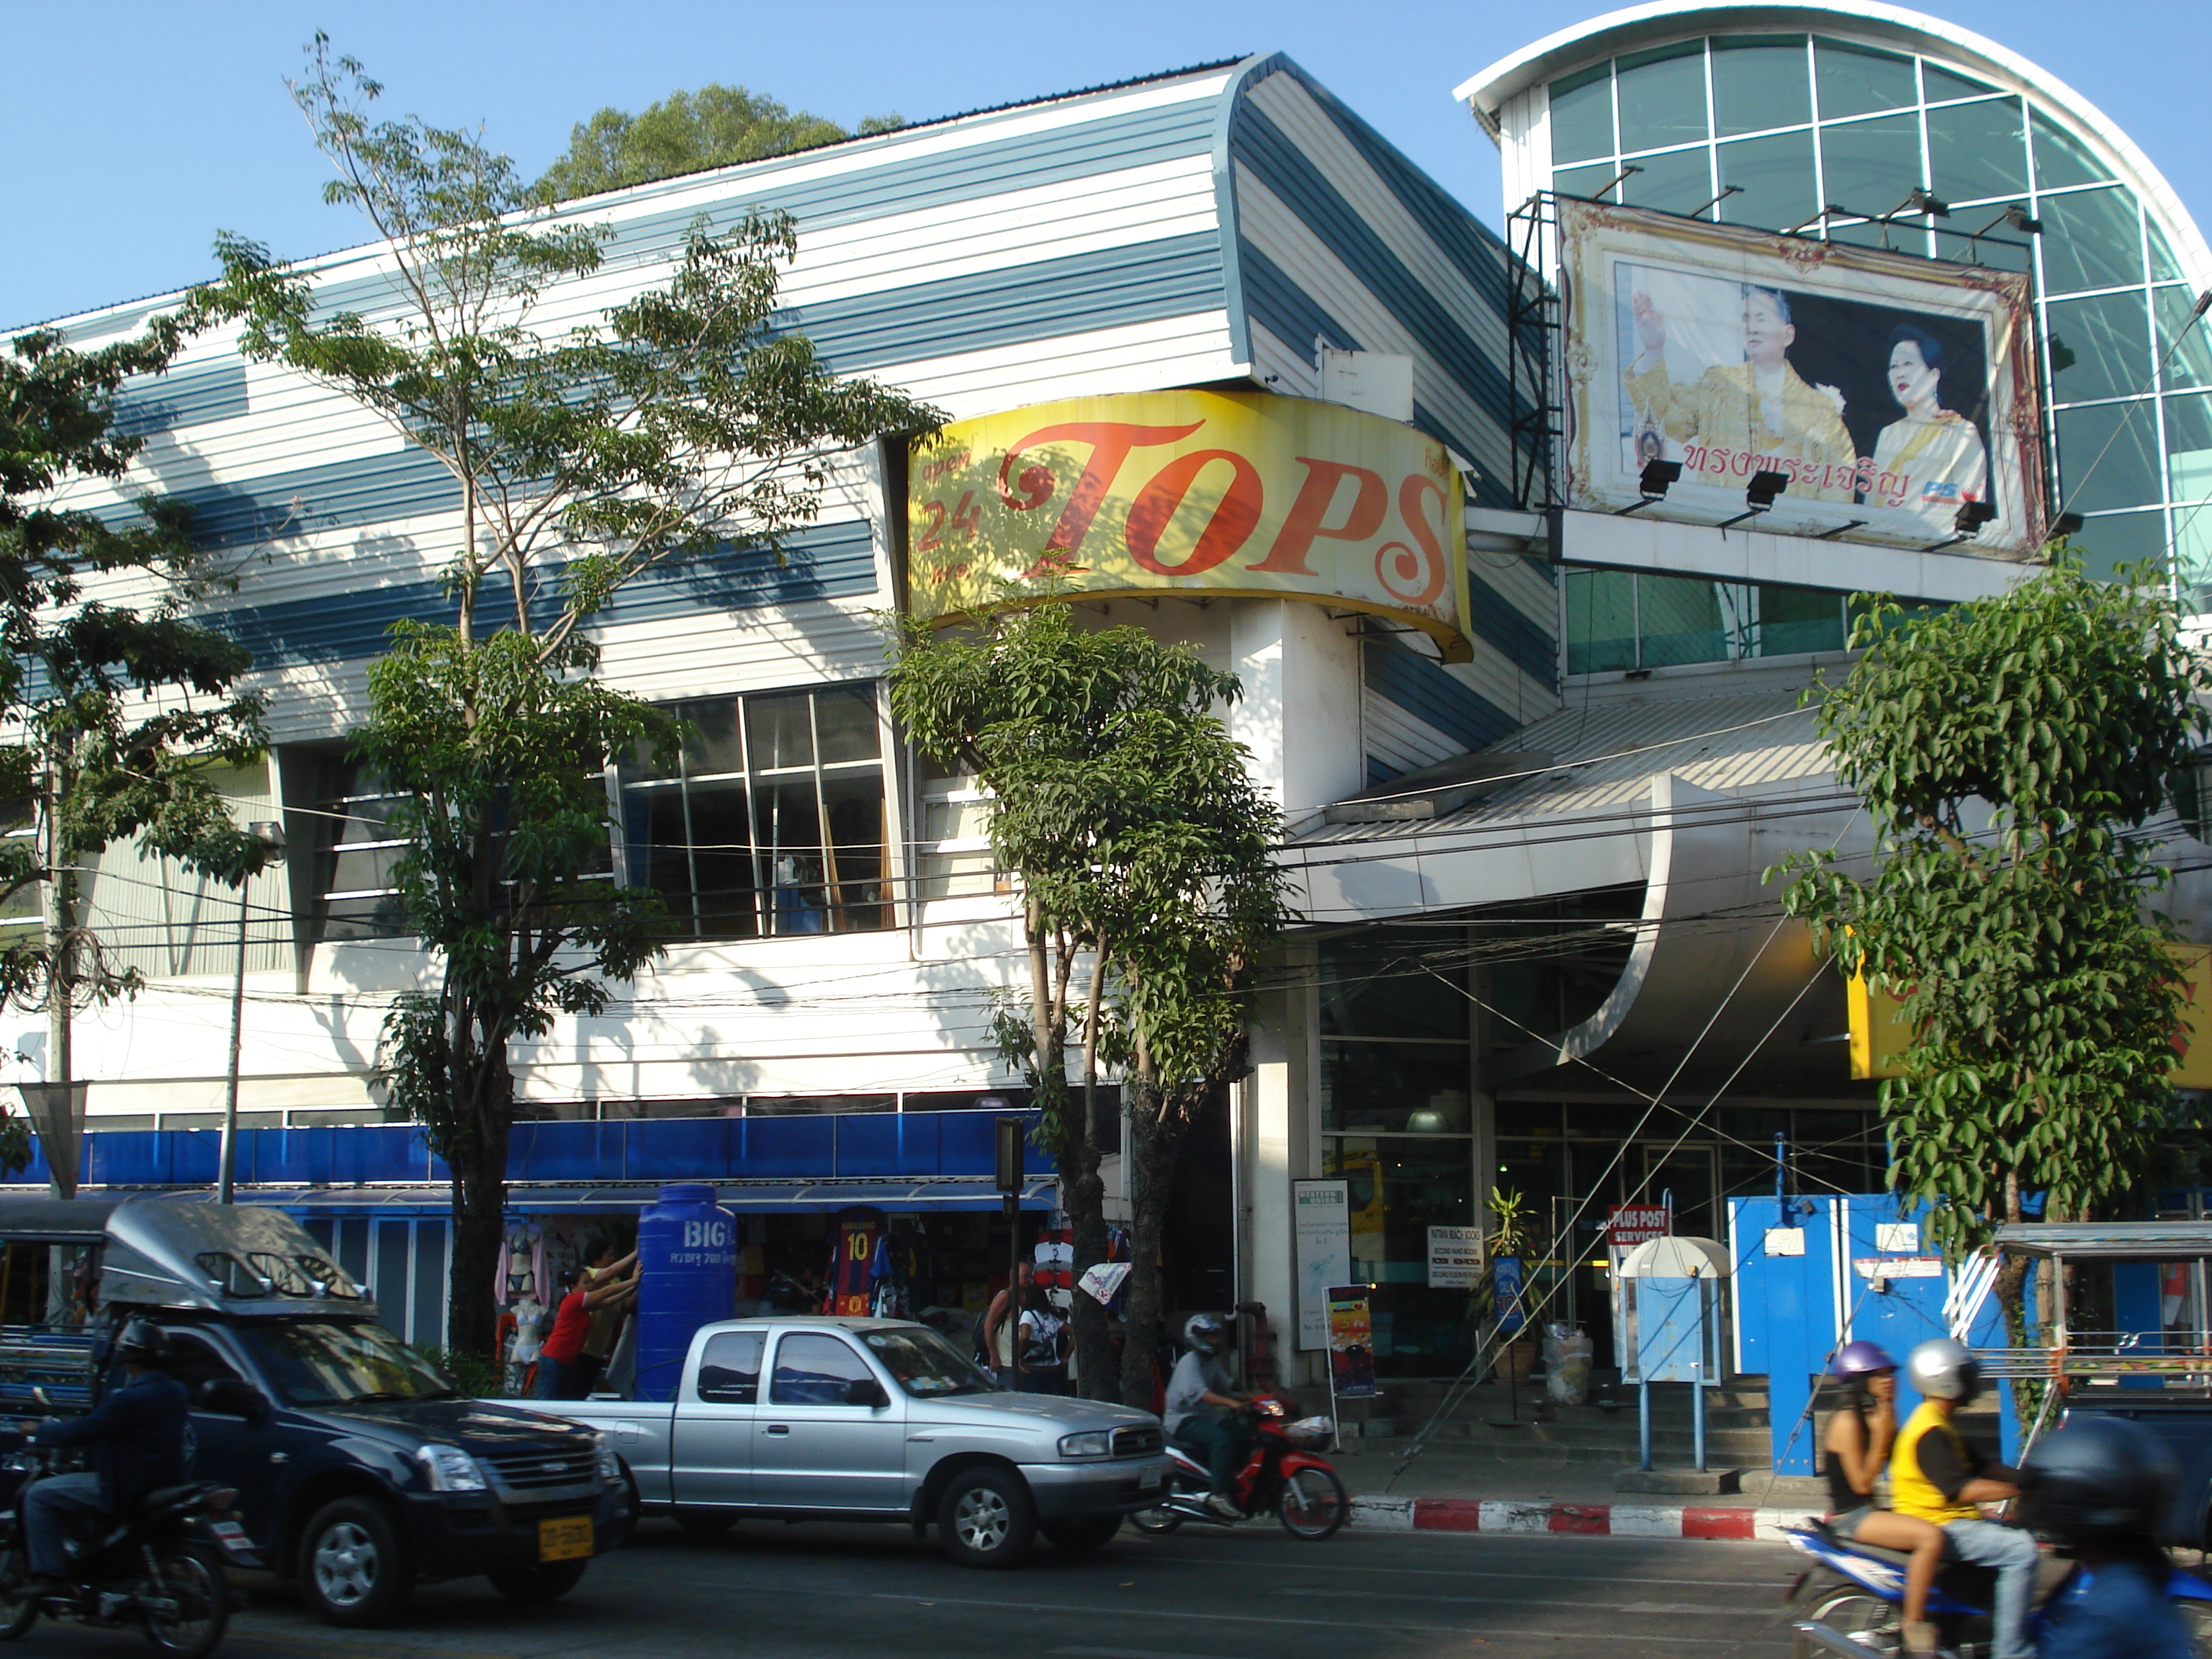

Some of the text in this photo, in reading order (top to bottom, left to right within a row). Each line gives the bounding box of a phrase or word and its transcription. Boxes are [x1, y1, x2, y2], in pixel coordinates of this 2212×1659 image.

[922, 451, 971, 485] open
[1681, 444, 1910, 508] ทรงพระเจริญ
[1922, 480, 1958, 497] PS
[917, 488, 981, 553] 24
[998, 418, 1449, 606] TOPS
[931, 562, 971, 586] hrs.
[1613, 1210, 1666, 1228] PLUS POST
[683, 1220, 727, 1248] BIG
[848, 1232, 868, 1261] 10
[1449, 1229, 1464, 1240] BEACH
[1465, 1230, 1480, 1241] BOOKS
[1777, 1234, 1802, 1251] 50
[1341, 1317, 1350, 1329] 3
